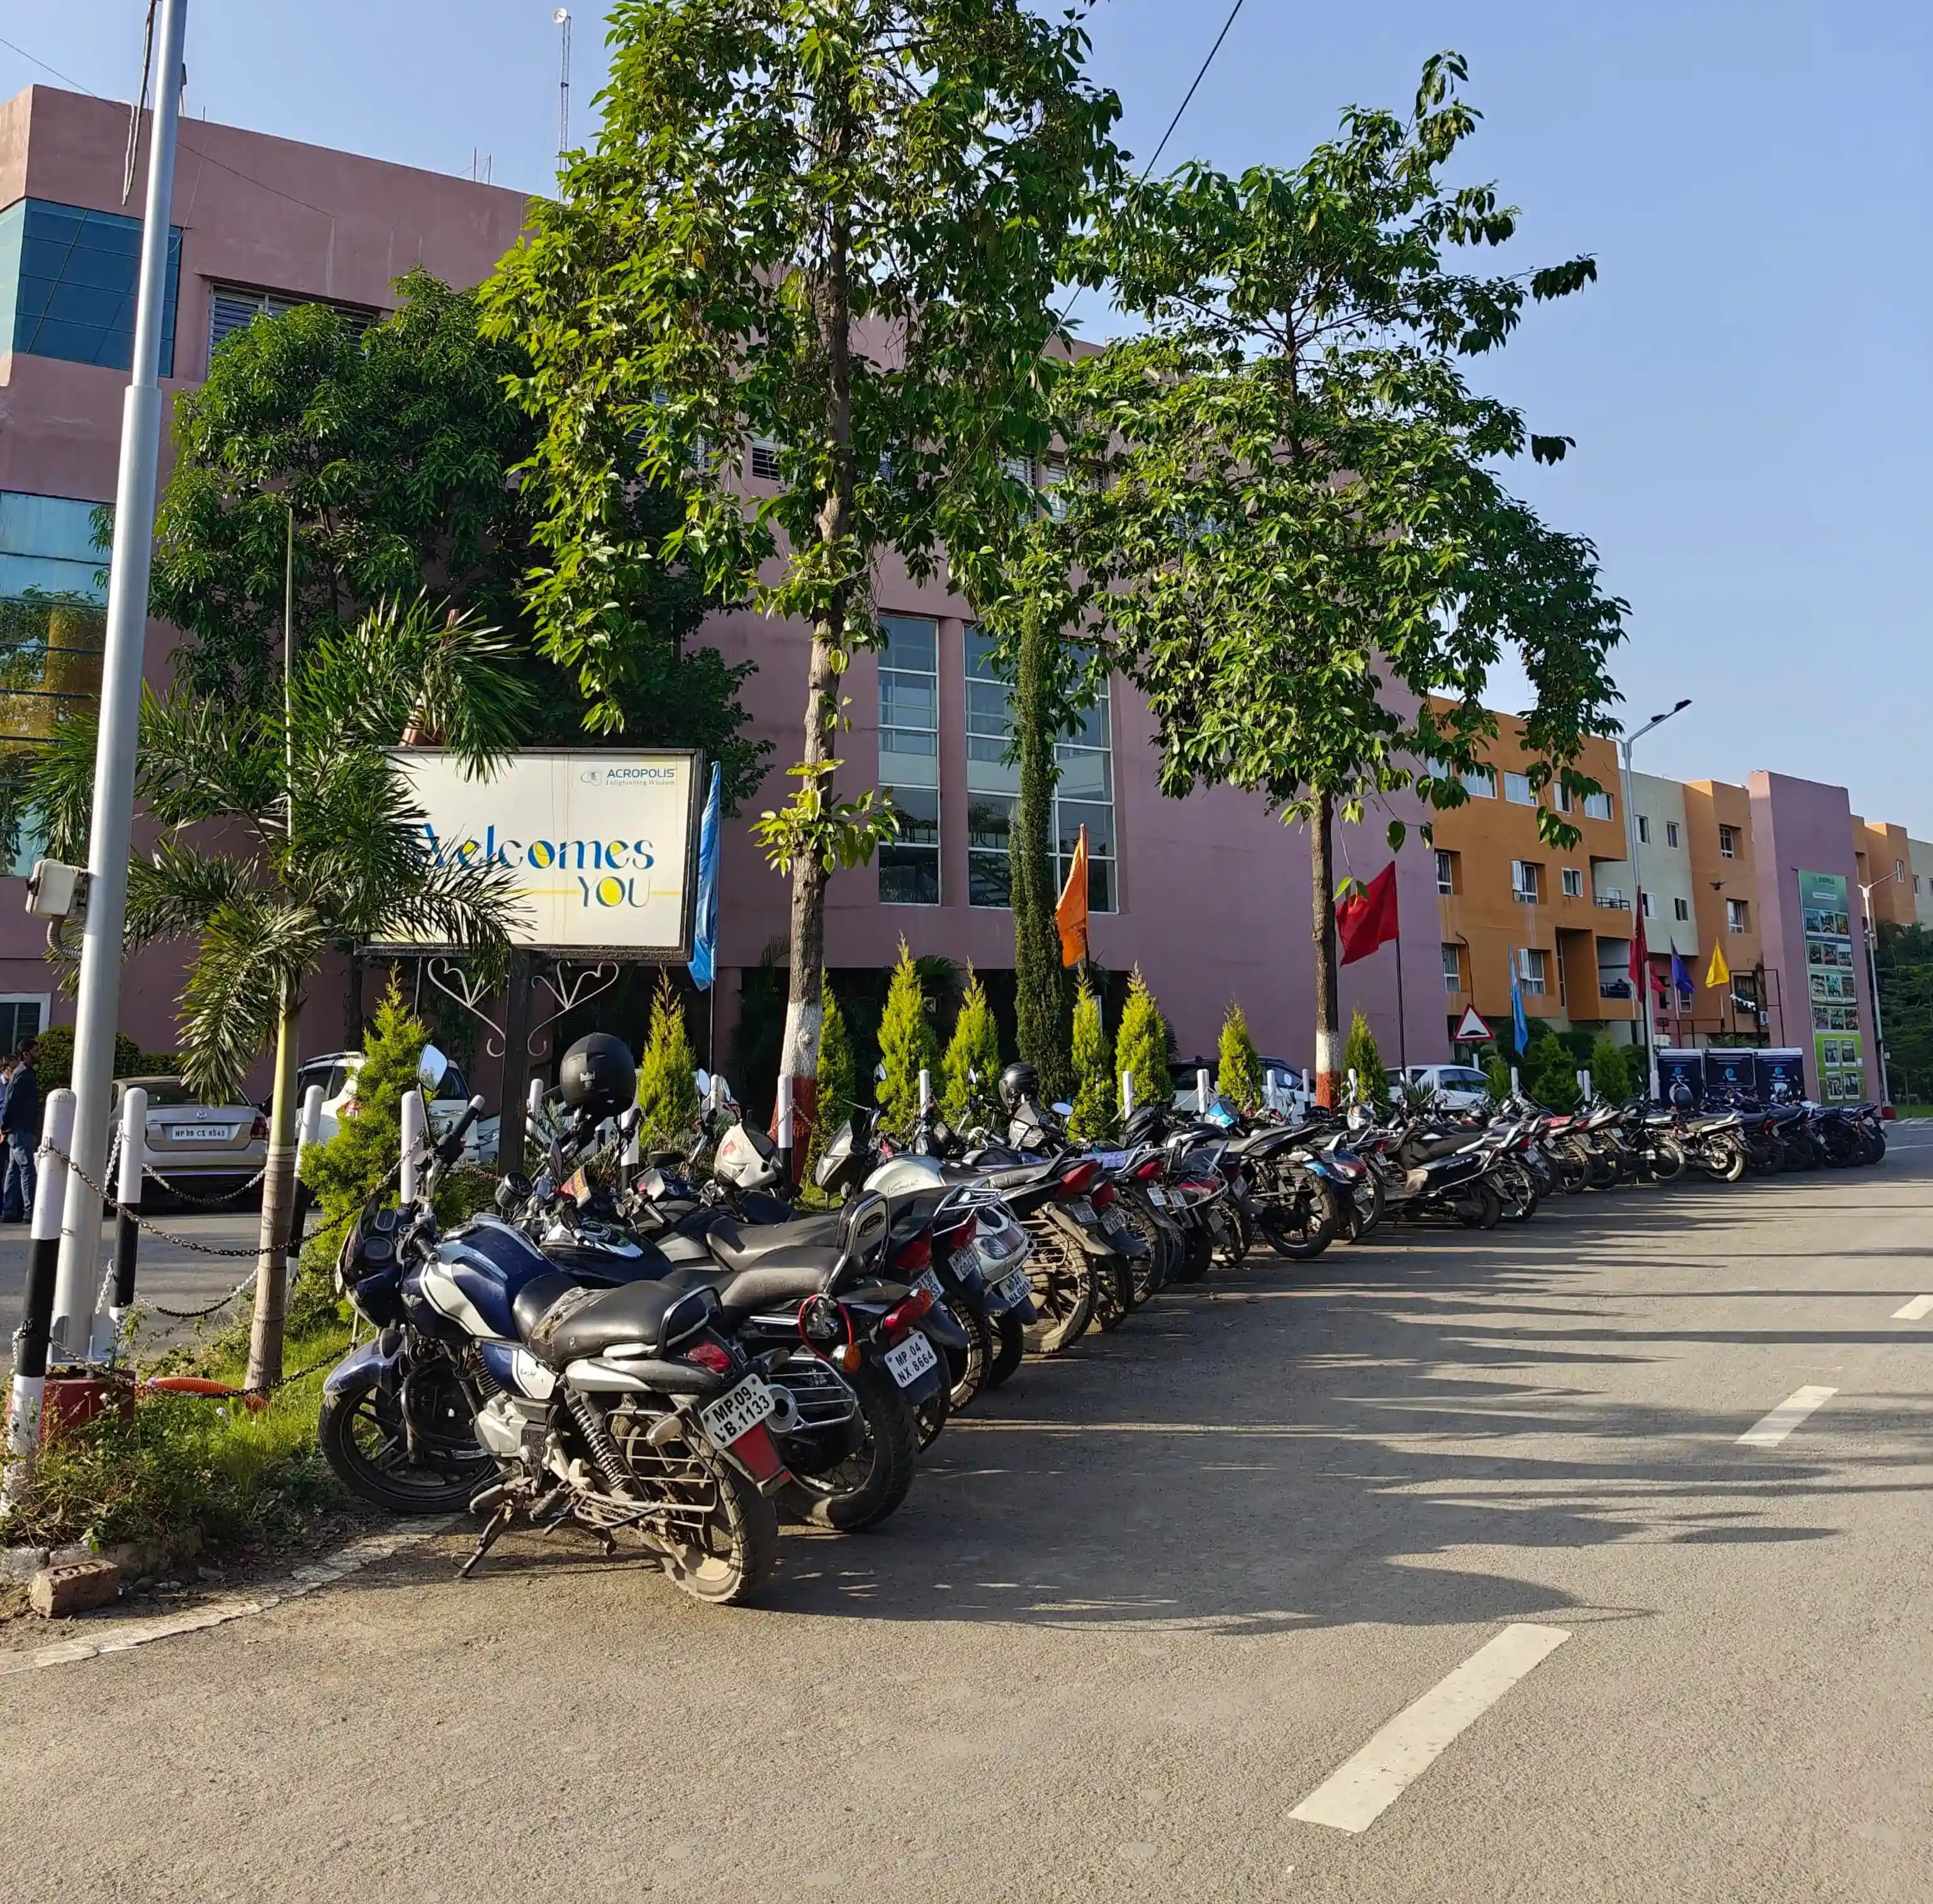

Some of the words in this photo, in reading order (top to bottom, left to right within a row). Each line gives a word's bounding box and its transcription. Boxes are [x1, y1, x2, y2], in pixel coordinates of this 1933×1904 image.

[607, 769, 675, 778] ACROPOLIS
[577, 875, 651, 908] YOU
[912, 1350, 934, 1372] 8664
